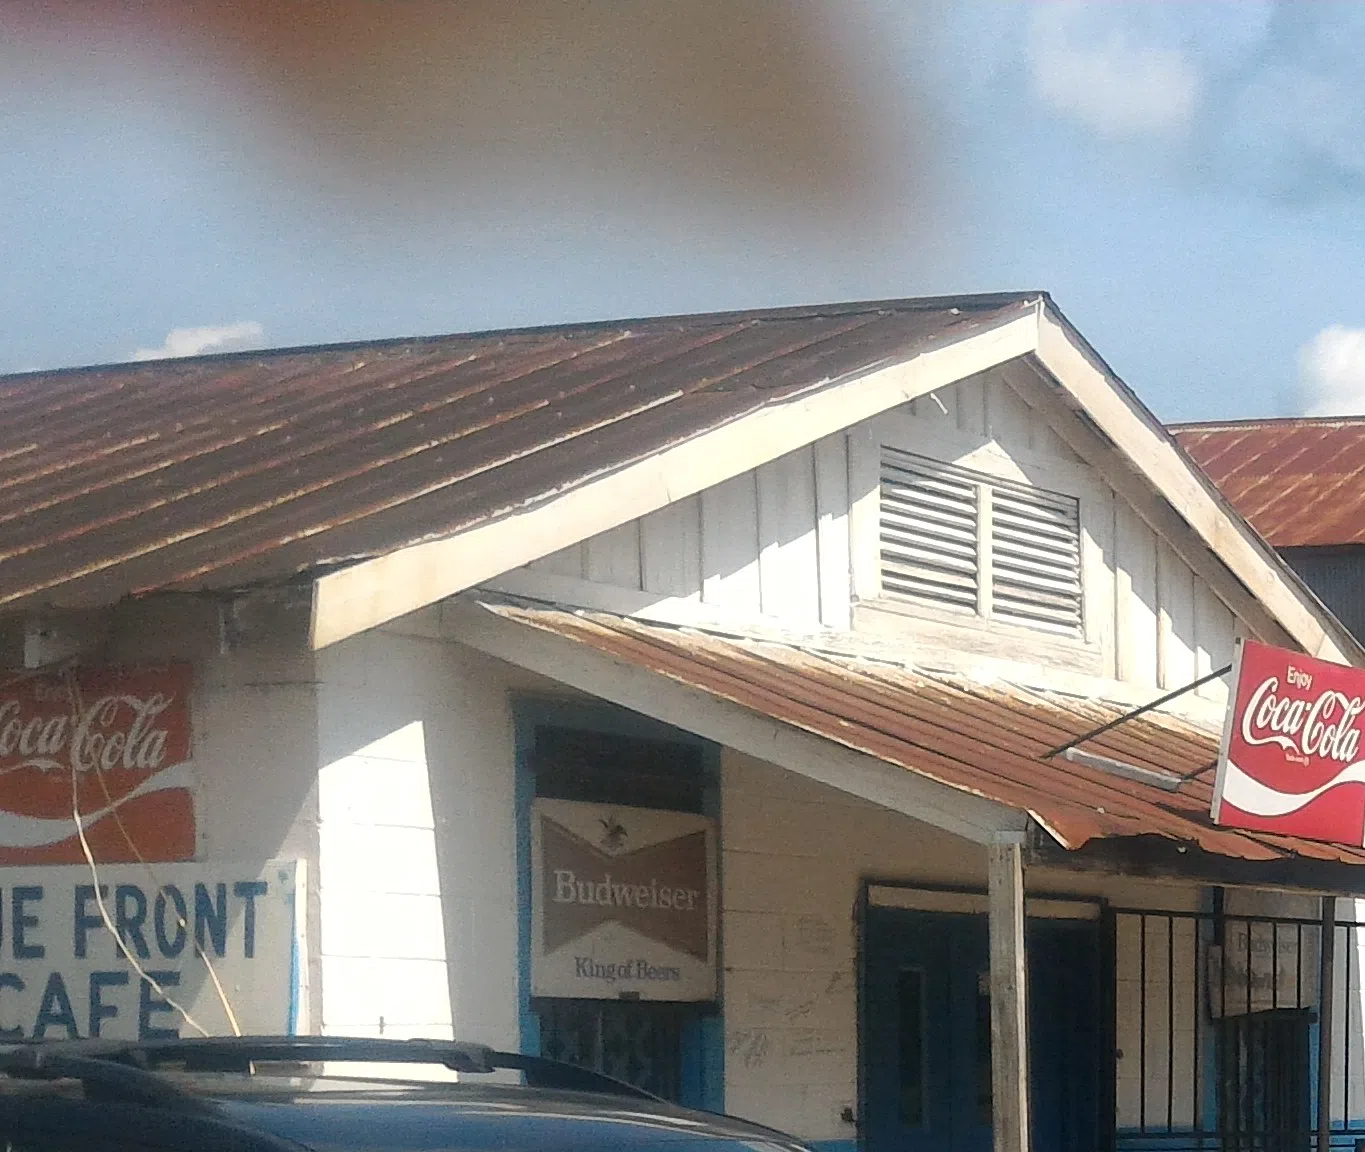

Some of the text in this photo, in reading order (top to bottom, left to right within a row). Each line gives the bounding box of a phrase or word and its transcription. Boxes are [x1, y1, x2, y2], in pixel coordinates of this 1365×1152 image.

[1287, 665, 1313, 691] Enjoy
[551, 869, 700, 911] Budweiser
[74, 881, 268, 958] FRONT
[574, 956, 681, 984] King of Beers
[0, 970, 181, 1040] CAFE
